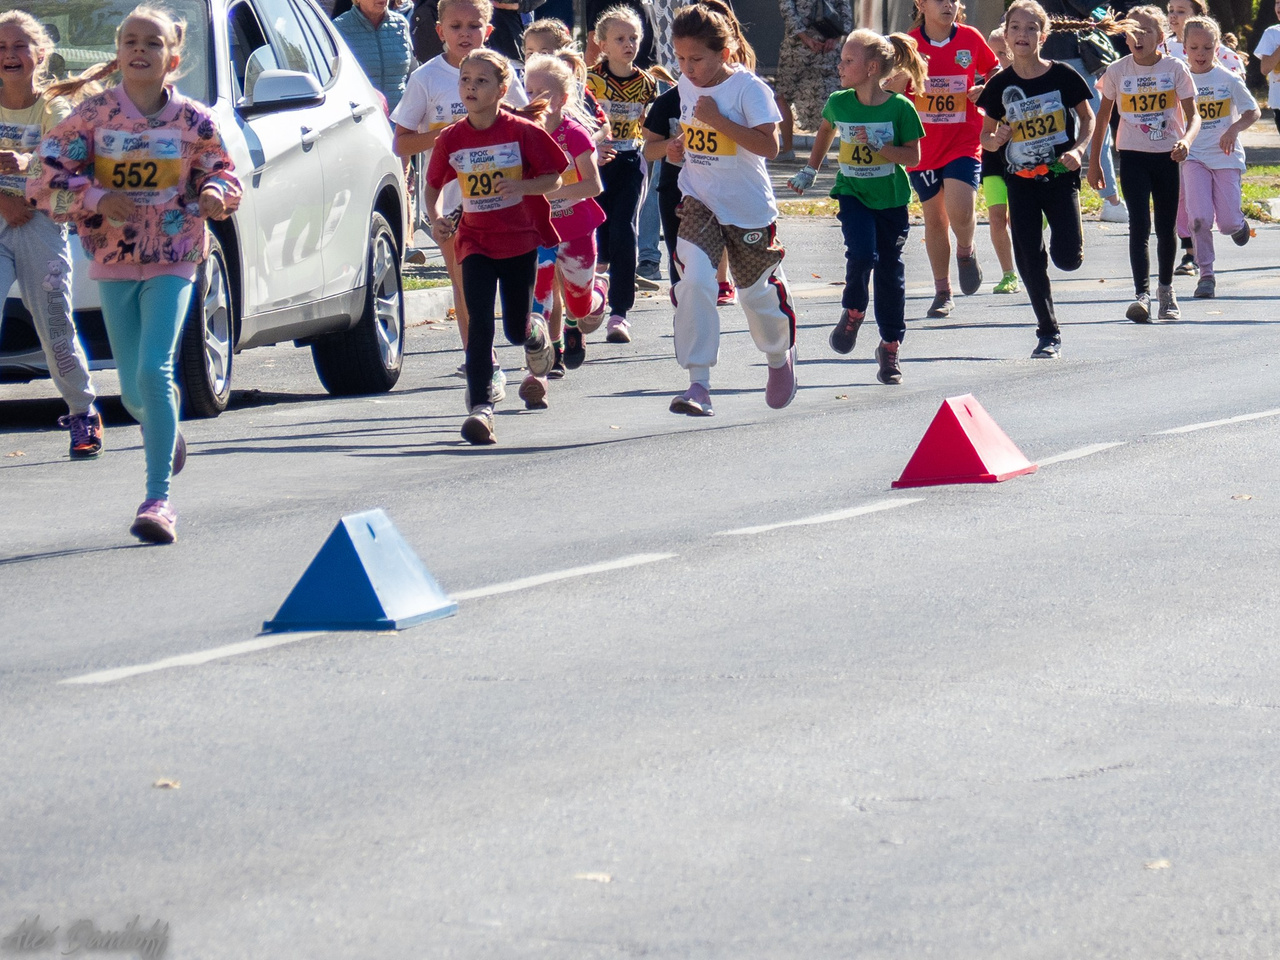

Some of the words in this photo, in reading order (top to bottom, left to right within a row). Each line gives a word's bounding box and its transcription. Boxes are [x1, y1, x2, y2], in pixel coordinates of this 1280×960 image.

[926, 95, 955, 112] 766
[1129, 93, 1167, 112] 1376
[1017, 115, 1057, 140] 1532
[687, 127, 718, 153] 235
[851, 145, 873, 164] 43
[112, 161, 158, 188] 552
[920, 169, 938, 187] 12
